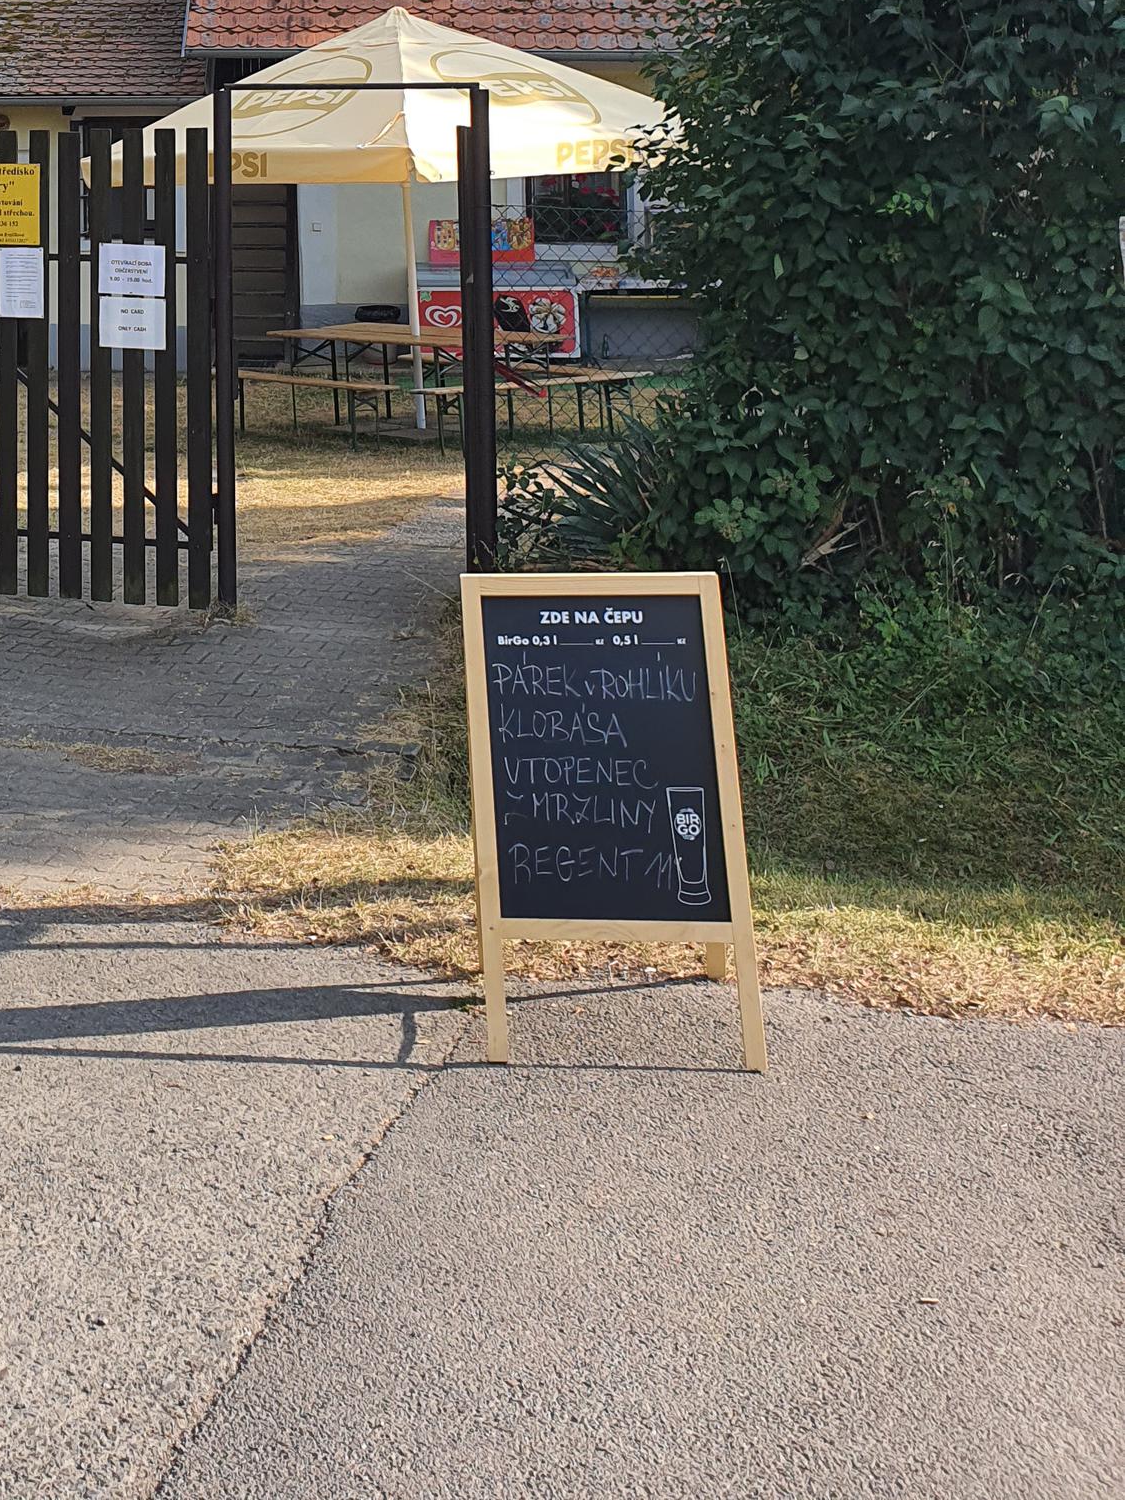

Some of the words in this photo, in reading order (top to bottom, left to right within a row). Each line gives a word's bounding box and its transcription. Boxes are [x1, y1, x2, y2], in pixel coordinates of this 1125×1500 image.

[478, 79, 578, 99] EPSI
[539, 610, 570, 625] ZDE
[574, 610, 600, 625] NA
[603, 607, 644, 625] ČEPU
[497, 635, 530, 646] BirGo
[532, 635, 551, 647] 0,3
[612, 635, 631, 647] 0,5
[498, 702, 628, 748] KLOBÁSA
[676, 813, 700, 825] BIR
[677, 824, 700, 836] GO
[508, 842, 644, 885] REGENT
